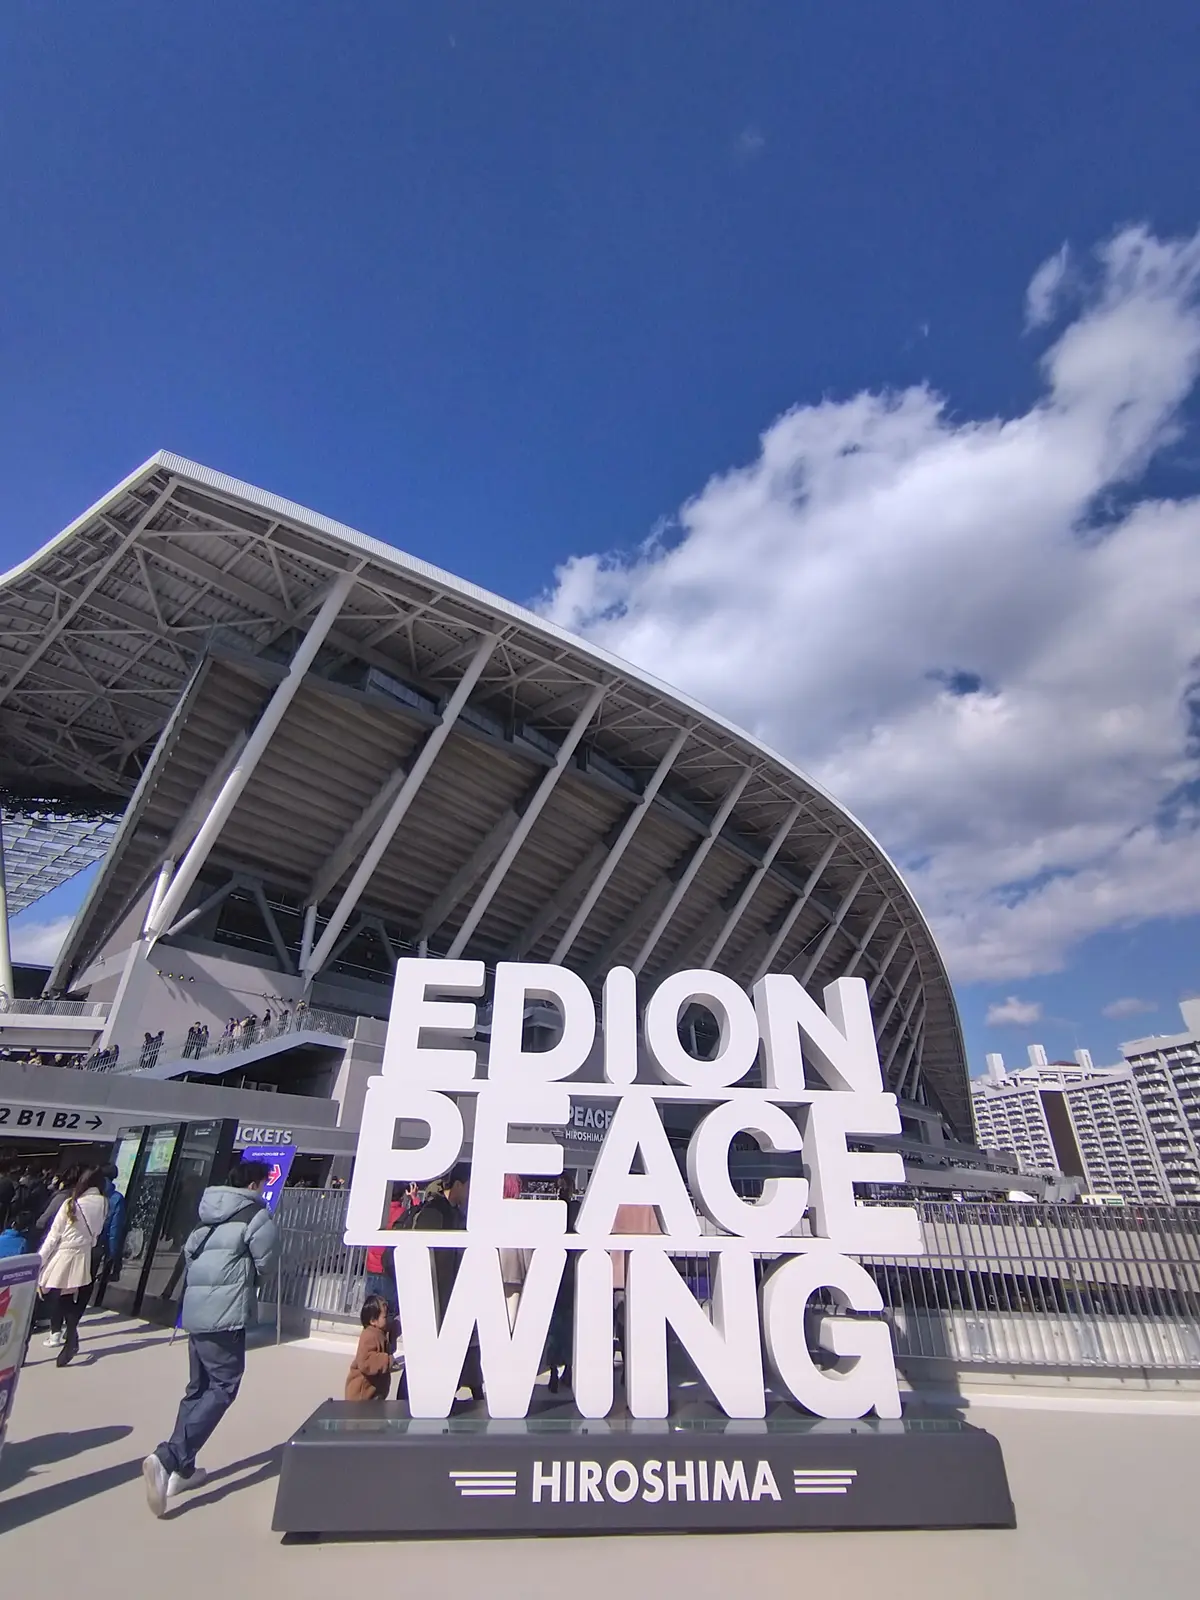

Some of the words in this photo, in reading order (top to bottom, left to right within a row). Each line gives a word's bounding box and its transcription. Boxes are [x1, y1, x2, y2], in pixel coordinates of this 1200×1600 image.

[381, 957, 884, 1092] EDION
[16, 1109, 47, 1127] B1
[52, 1112, 81, 1129] B2
[235, 1126, 293, 1144] ICKETS
[565, 1130, 604, 1143] HIROSHIMA
[346, 1088, 922, 1254] PEACE
[393, 1245, 903, 1419] WING
[532, 1459, 782, 1503] HIROSHIMA
